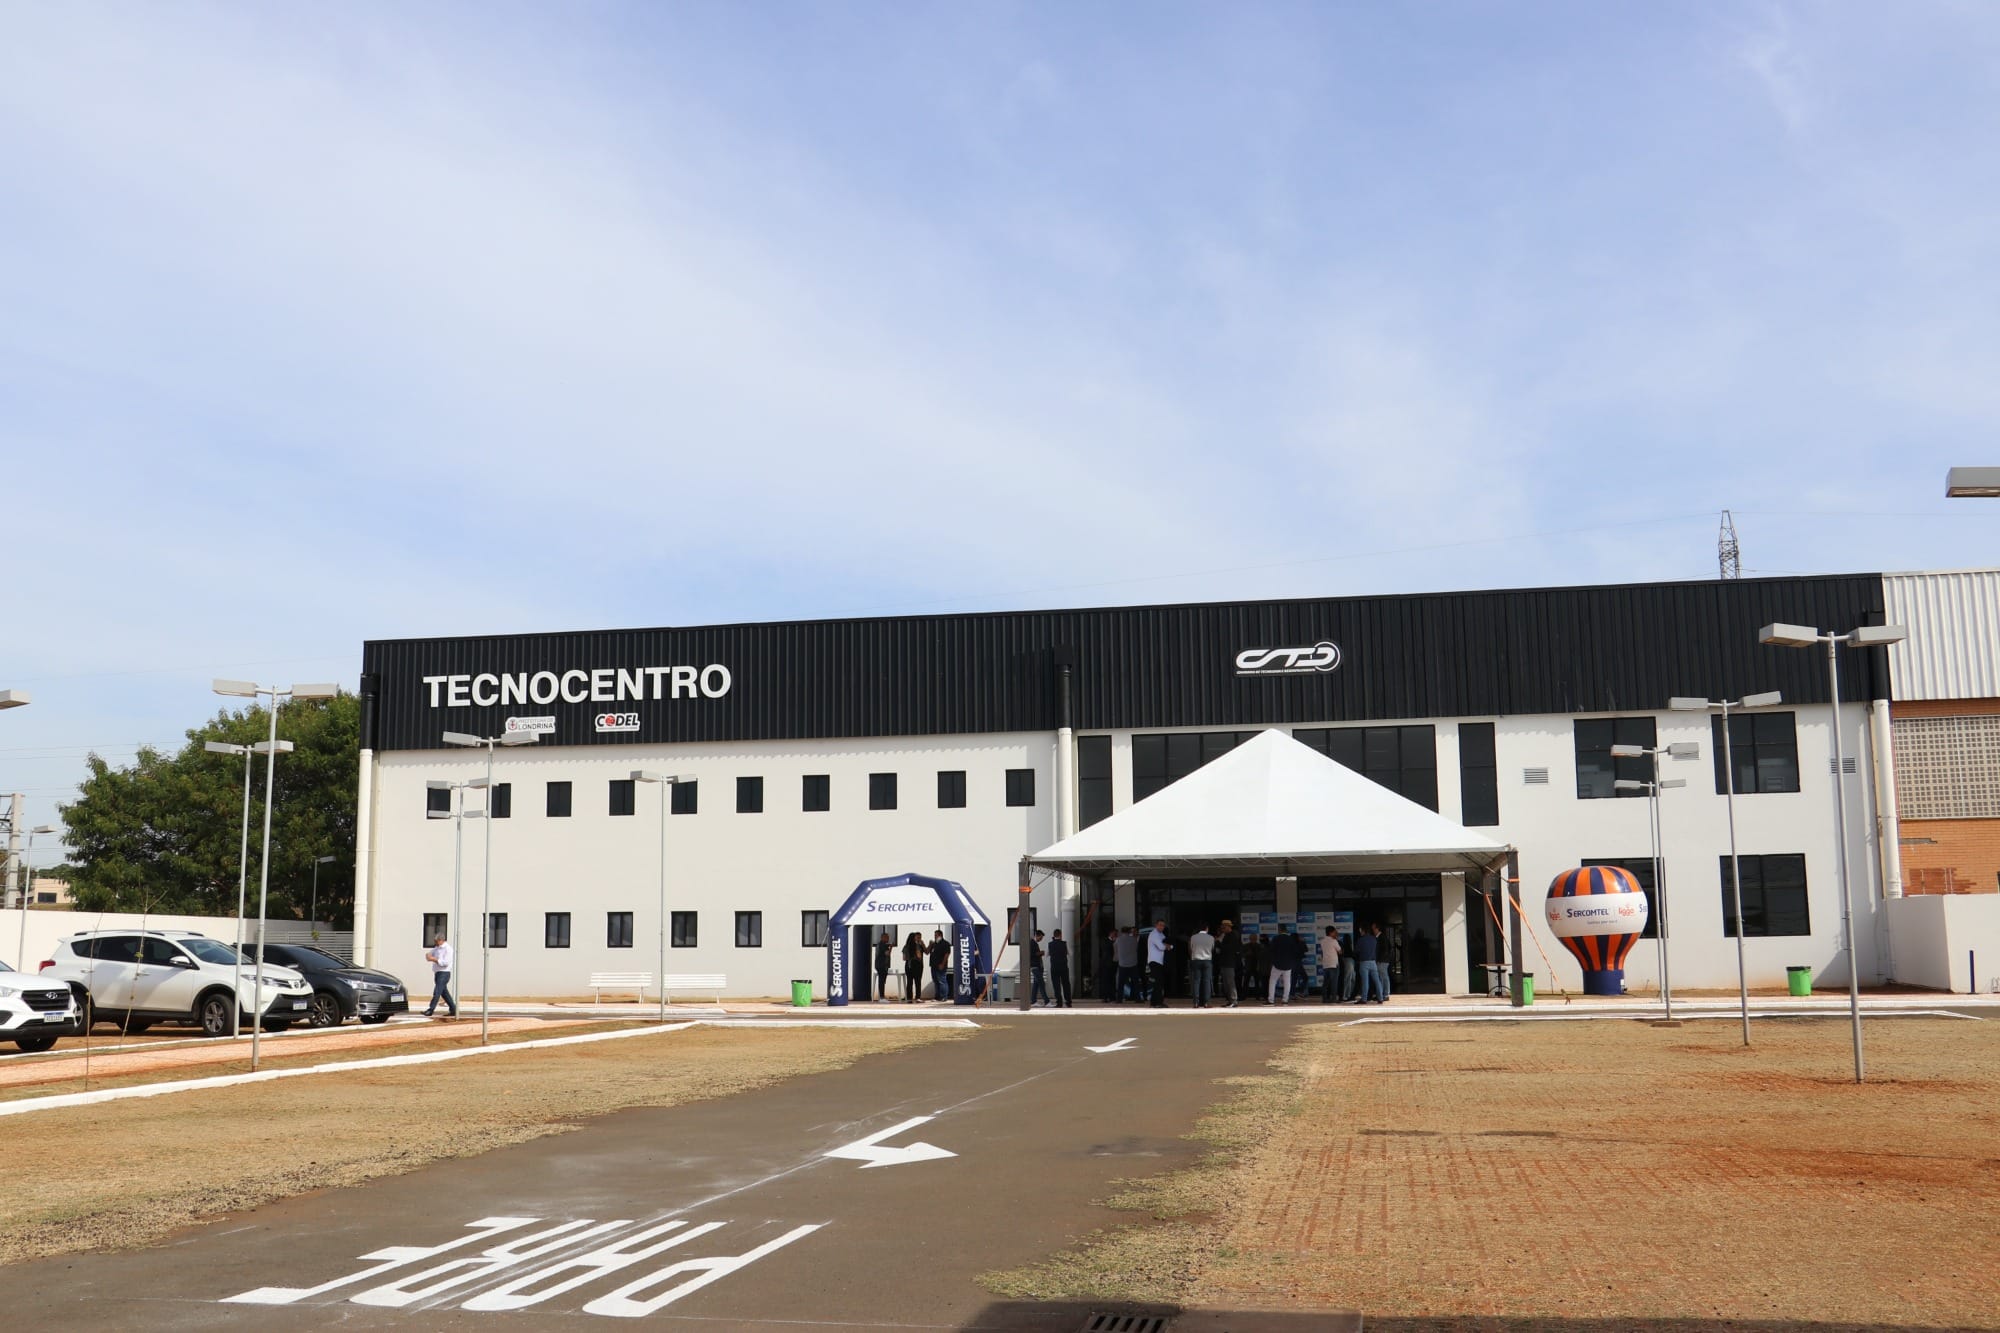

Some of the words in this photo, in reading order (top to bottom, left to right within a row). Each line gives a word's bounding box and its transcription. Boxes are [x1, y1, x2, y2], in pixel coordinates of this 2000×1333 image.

[423, 663, 732, 708] TECNOCENTRO
[518, 722, 554, 731] LONDRINA
[596, 714, 639, 727] CODEL
[866, 901, 934, 912] SERCOMTEL
[1566, 908, 1609, 918] SERCOMTEL
[830, 937, 843, 998] SERCOMTEL
[959, 936, 972, 996] SERCOMTEL
[218, 1216, 823, 1318] PARE
